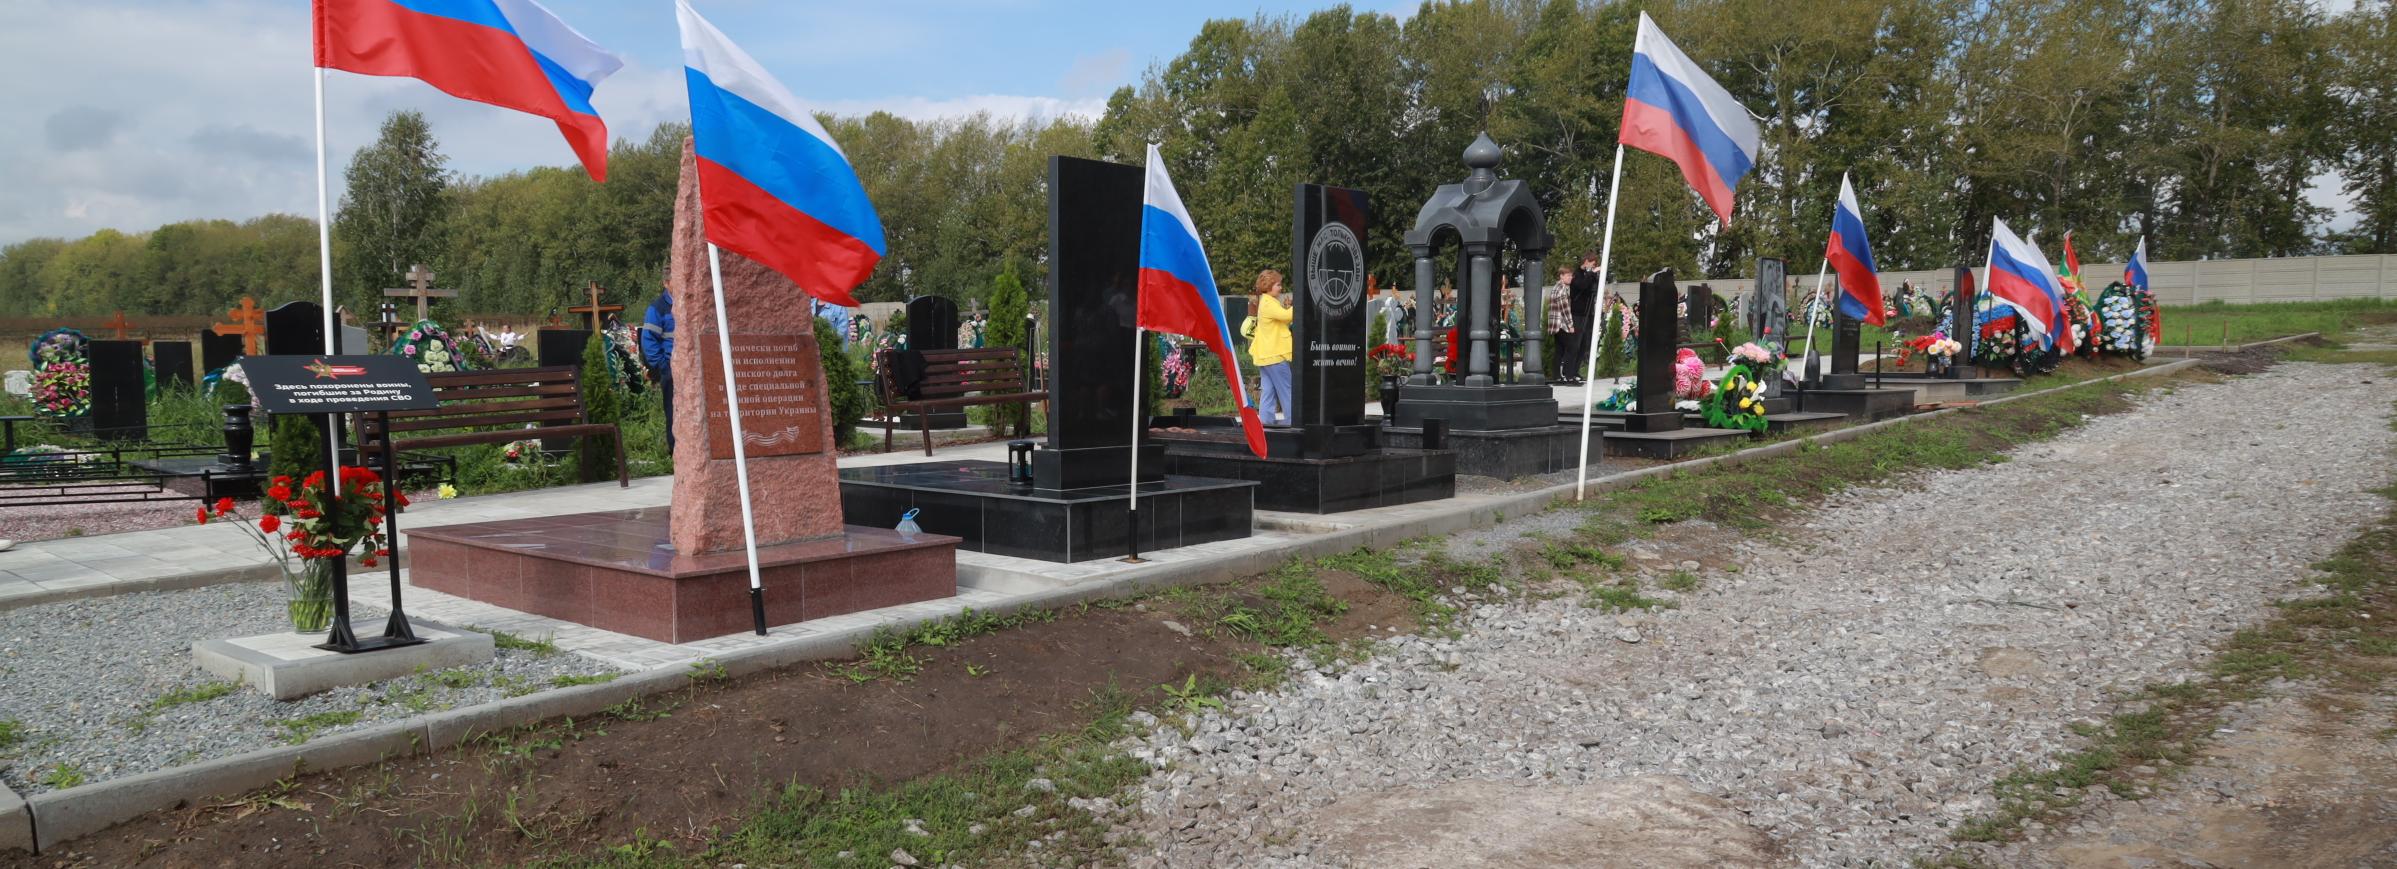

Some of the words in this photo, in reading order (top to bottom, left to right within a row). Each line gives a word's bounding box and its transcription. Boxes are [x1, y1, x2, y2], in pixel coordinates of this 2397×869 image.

[1329, 229, 1351, 244] ТОЛЬКО
[773, 343, 798, 353] погиб
[1310, 340, 1330, 351] Быть
[743, 357, 796, 366] исполнении
[1312, 359, 1335, 367] жить
[1335, 355, 1358, 367] вечно!
[773, 369, 798, 379] долга
[749, 380, 805, 391] специальной
[293, 389, 348, 397] погибшие
[364, 389, 401, 397] Родину
[325, 396, 390, 404] проведения
[762, 394, 804, 405] операции
[710, 410, 720, 418] на
[722, 408, 777, 419] тритории
[779, 406, 817, 418] Украины
